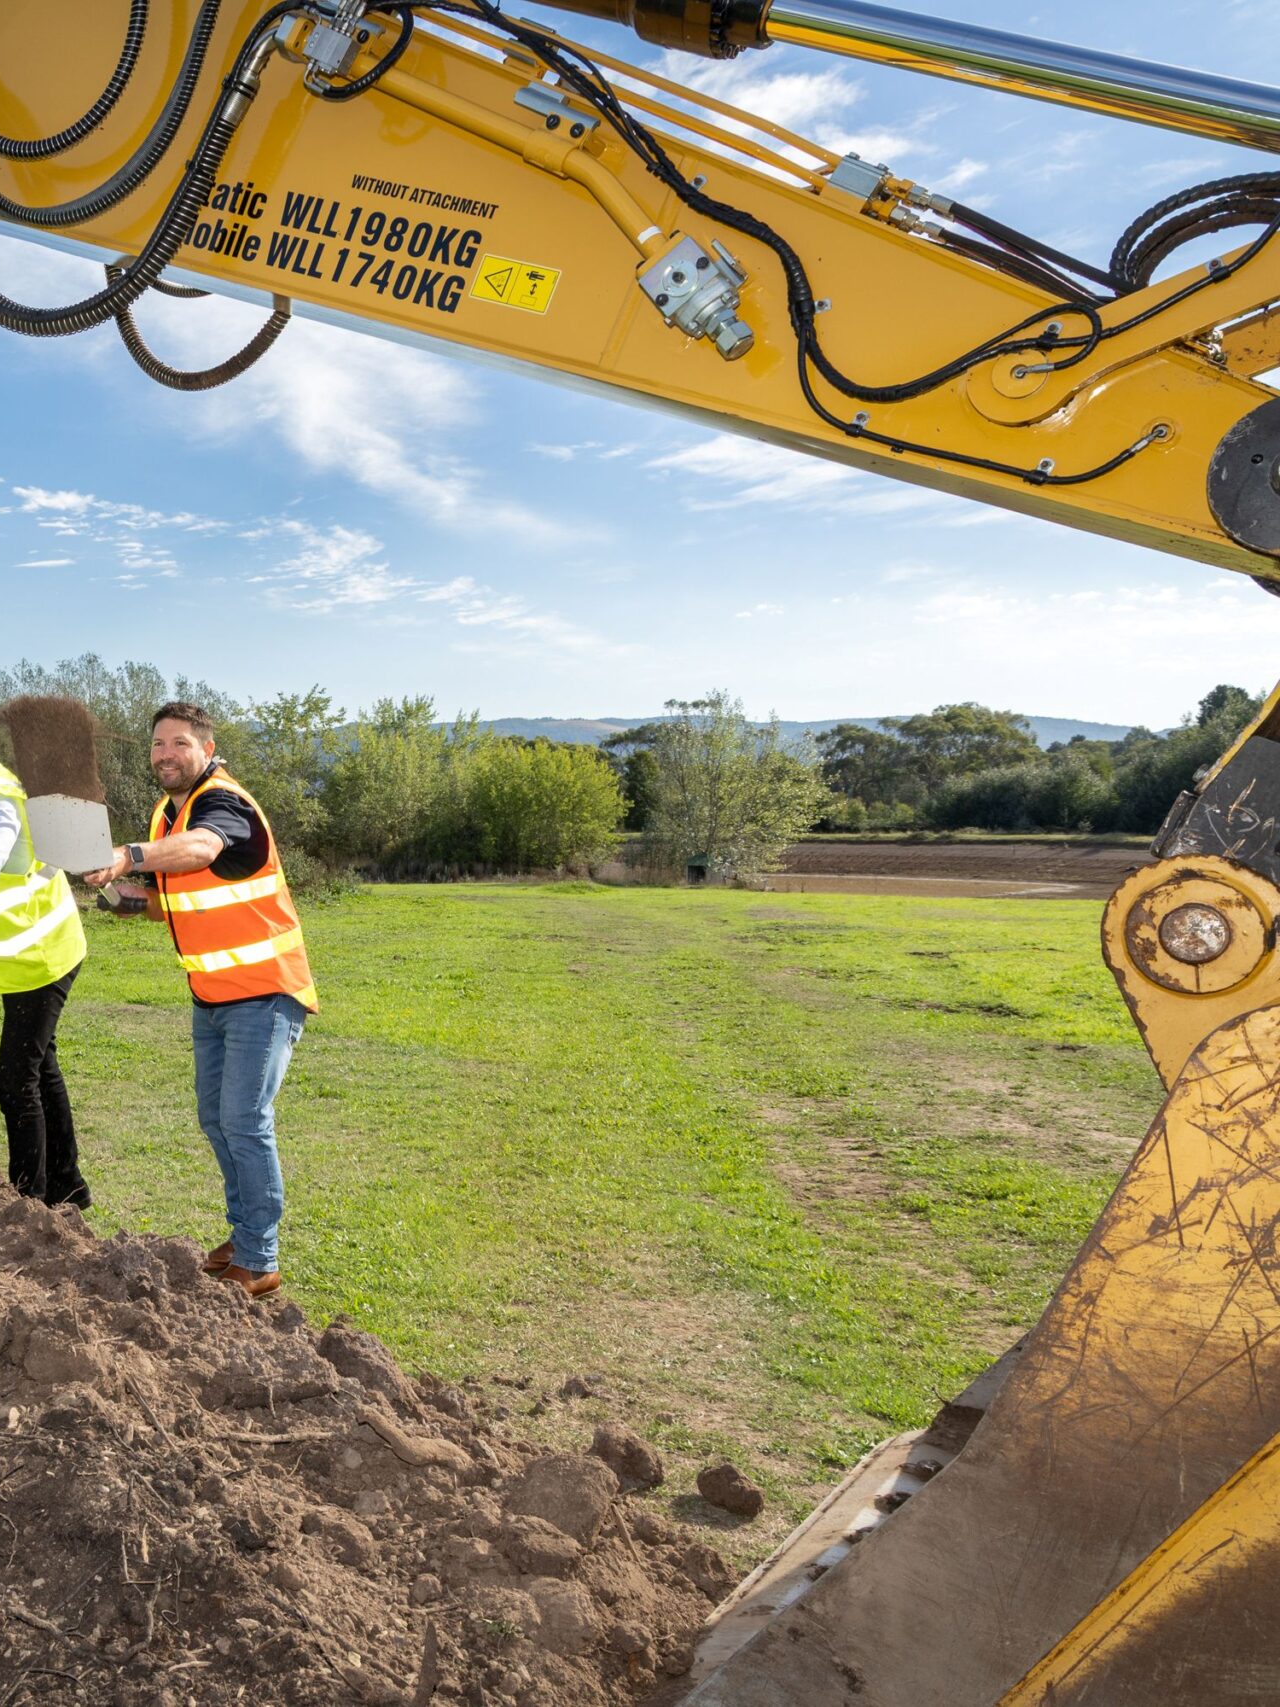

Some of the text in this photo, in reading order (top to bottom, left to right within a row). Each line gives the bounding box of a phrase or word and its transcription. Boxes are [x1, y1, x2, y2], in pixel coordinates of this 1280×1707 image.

[201, 182, 267, 219] atic
[351, 174, 499, 220] WITHOUT ATTACHMENT
[184, 219, 261, 262] obile
[266, 231, 325, 279] WLL
